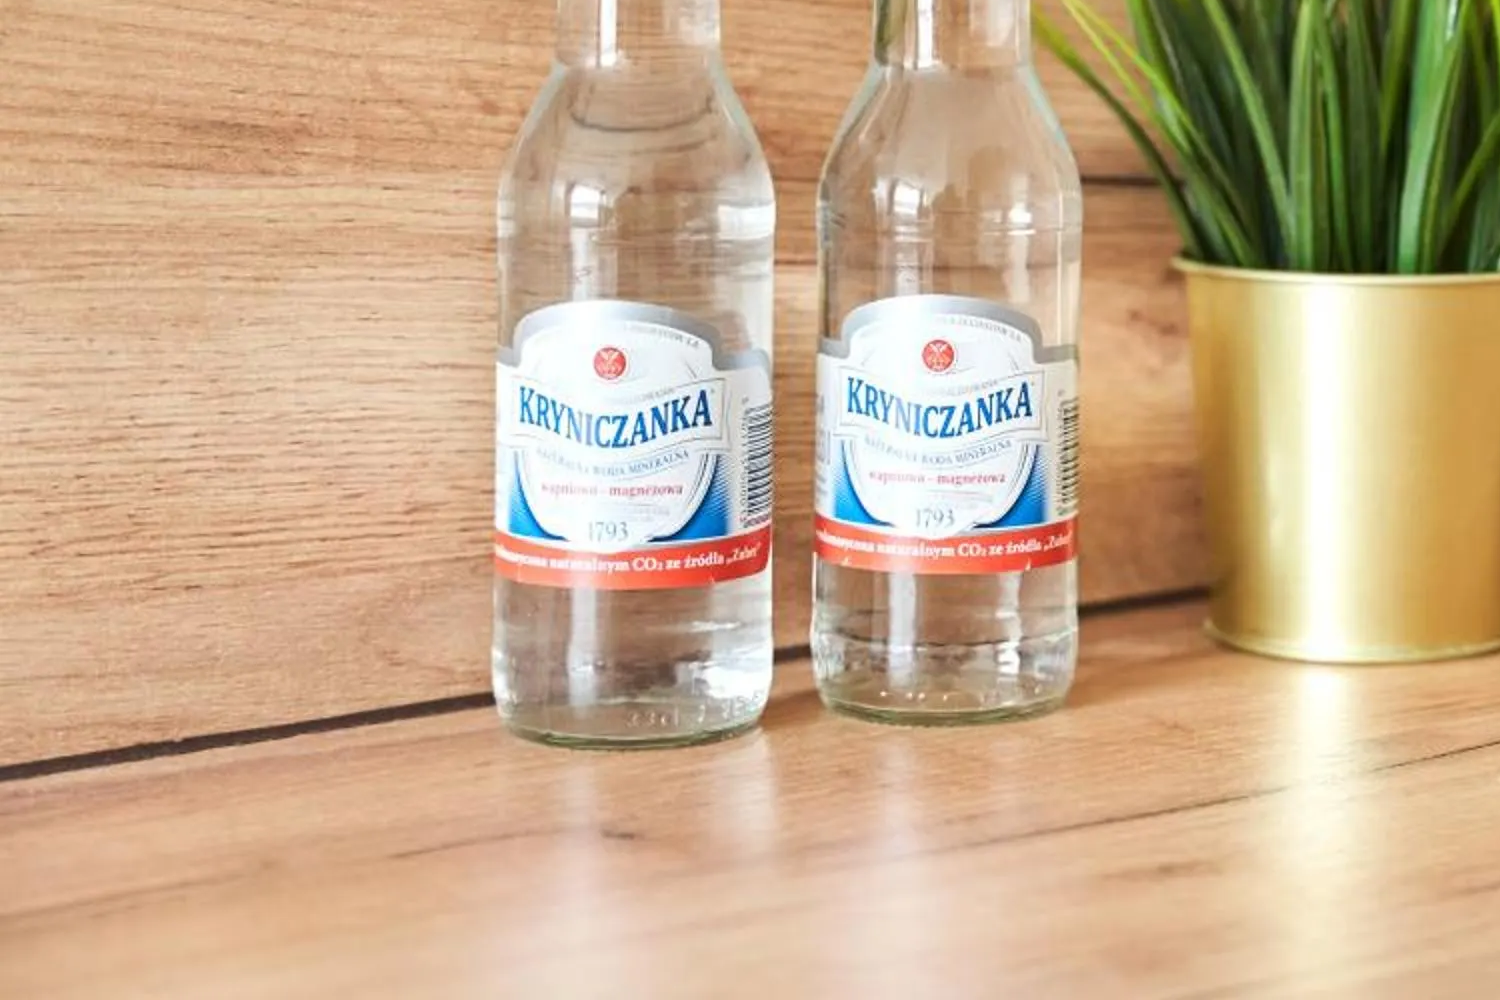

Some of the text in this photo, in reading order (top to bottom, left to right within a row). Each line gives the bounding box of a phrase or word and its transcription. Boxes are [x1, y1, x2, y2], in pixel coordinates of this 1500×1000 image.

[518, 386, 713, 449] KRYNICZANKA
[847, 376, 1033, 438] KRYNICZANKA
[628, 448, 690, 474] MINERALNA
[955, 438, 1013, 465] MINERALNA
[915, 508, 956, 528] 1793
[588, 520, 630, 543] 1793
[988, 545, 1004, 555] ze
[665, 559, 681, 569] ze
